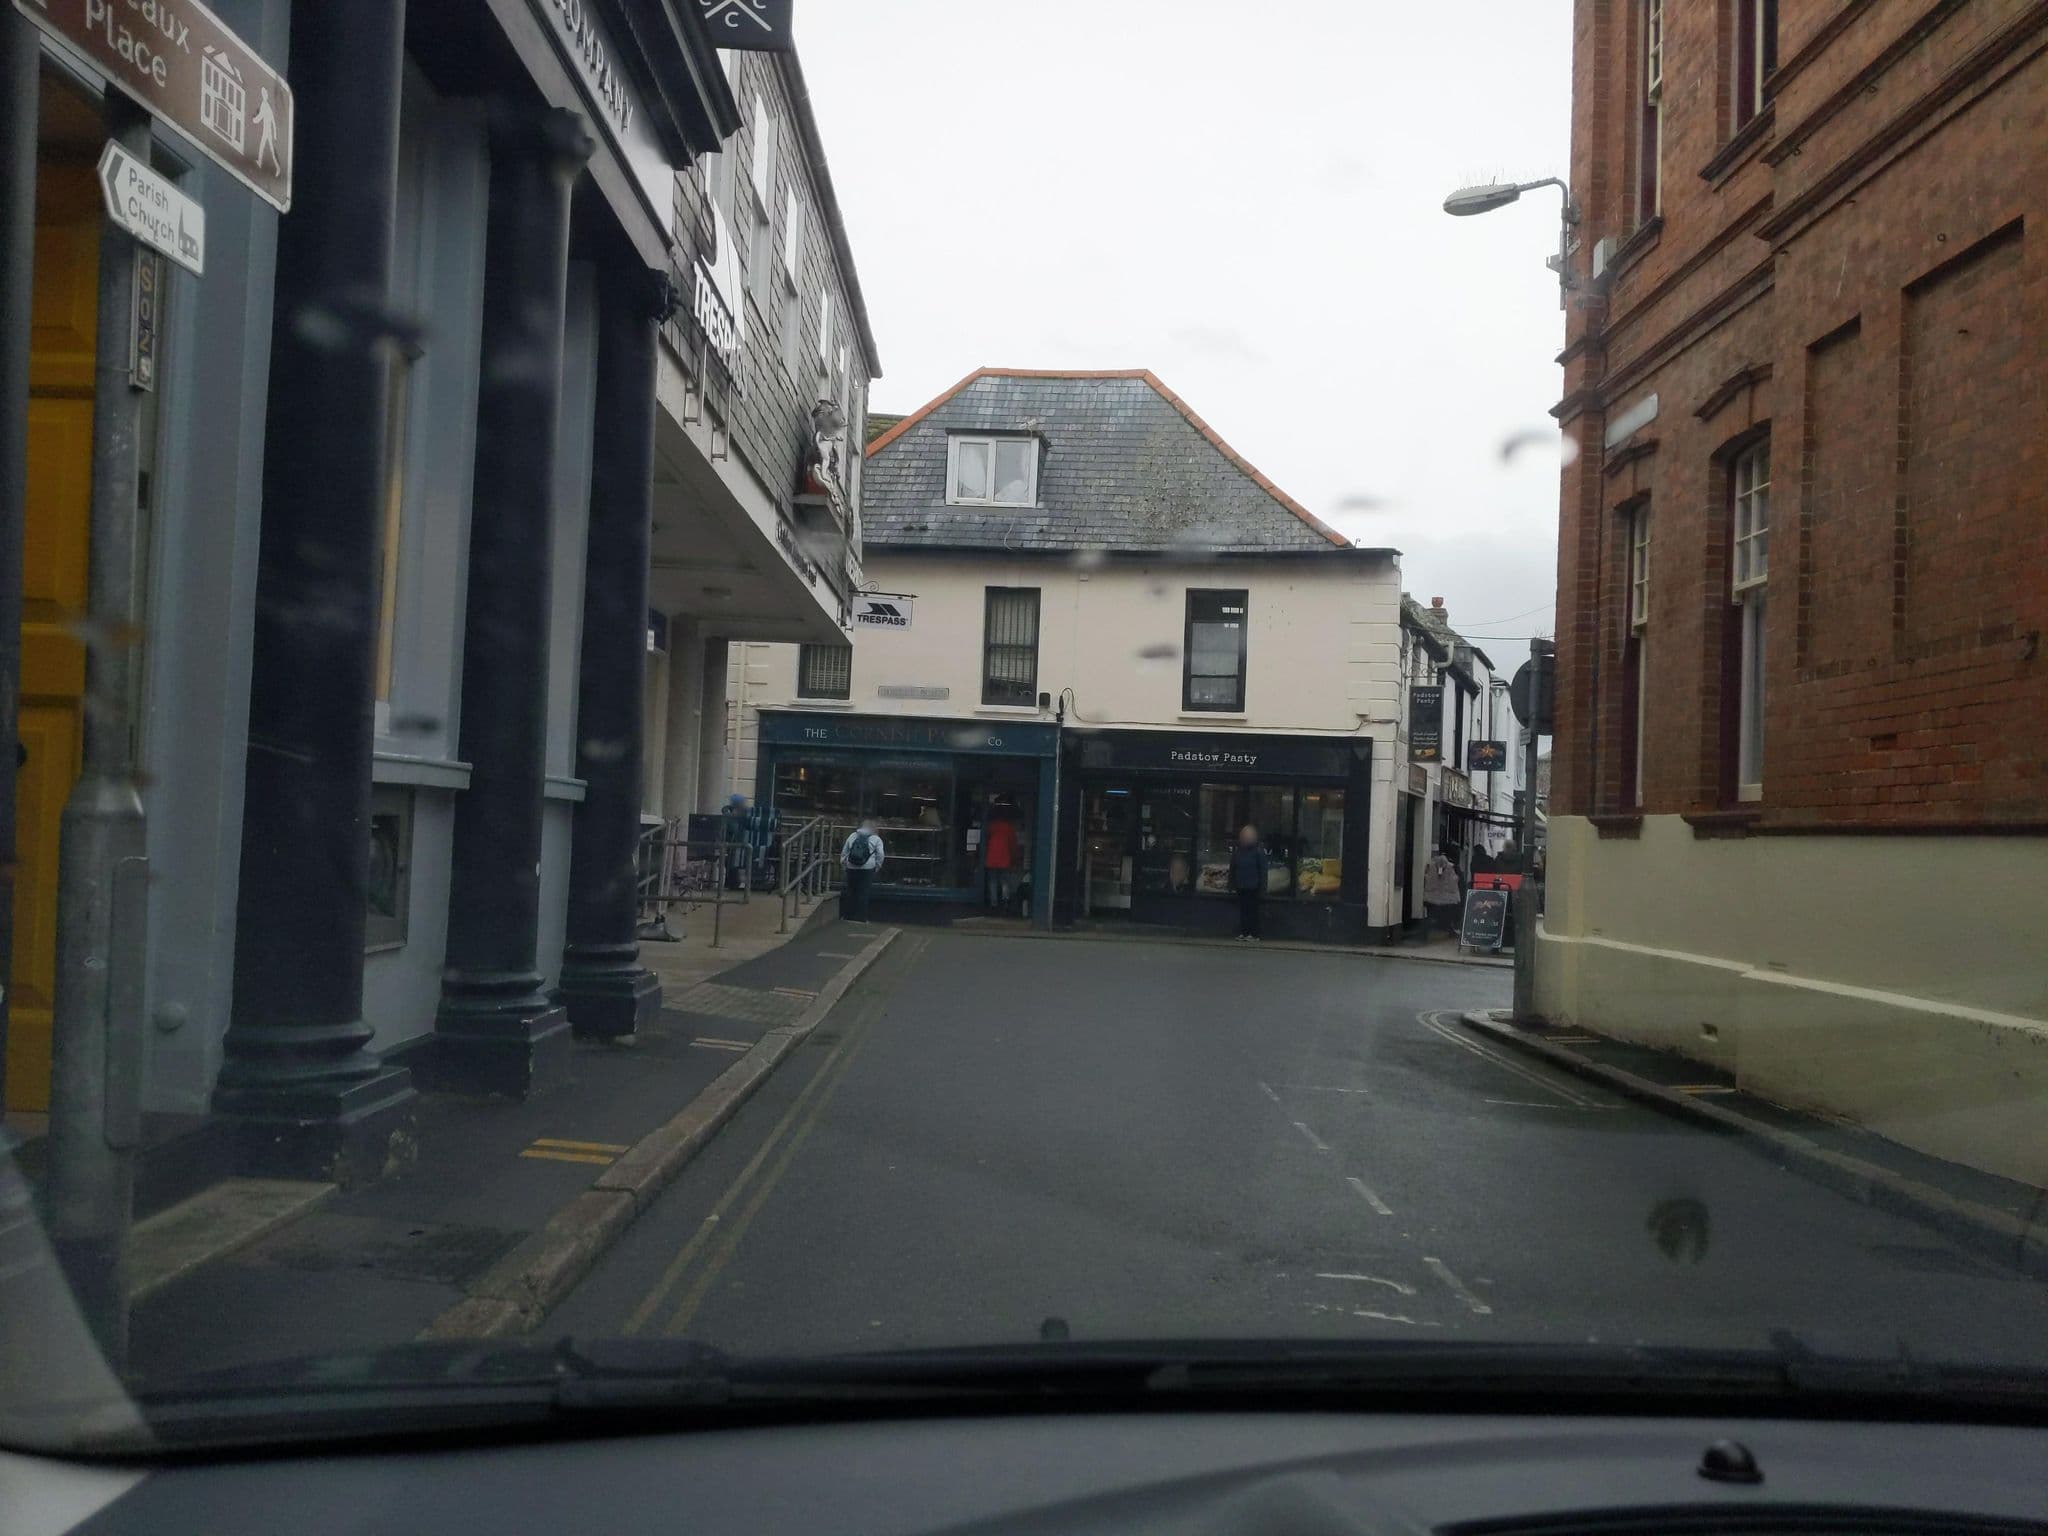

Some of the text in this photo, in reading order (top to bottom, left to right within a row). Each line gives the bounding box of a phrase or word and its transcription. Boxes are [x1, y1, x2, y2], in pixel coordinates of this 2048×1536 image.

[86, 0, 167, 88] Place
[559, 0, 634, 135] OMPANY
[129, 166, 169, 213] Parish
[128, 196, 175, 243] Church
[857, 614, 906, 626] TRESPASS
[804, 728, 828, 739] THE
[1171, 751, 1257, 765] Padstow Pasty
[1487, 831, 1506, 839] OPEN
